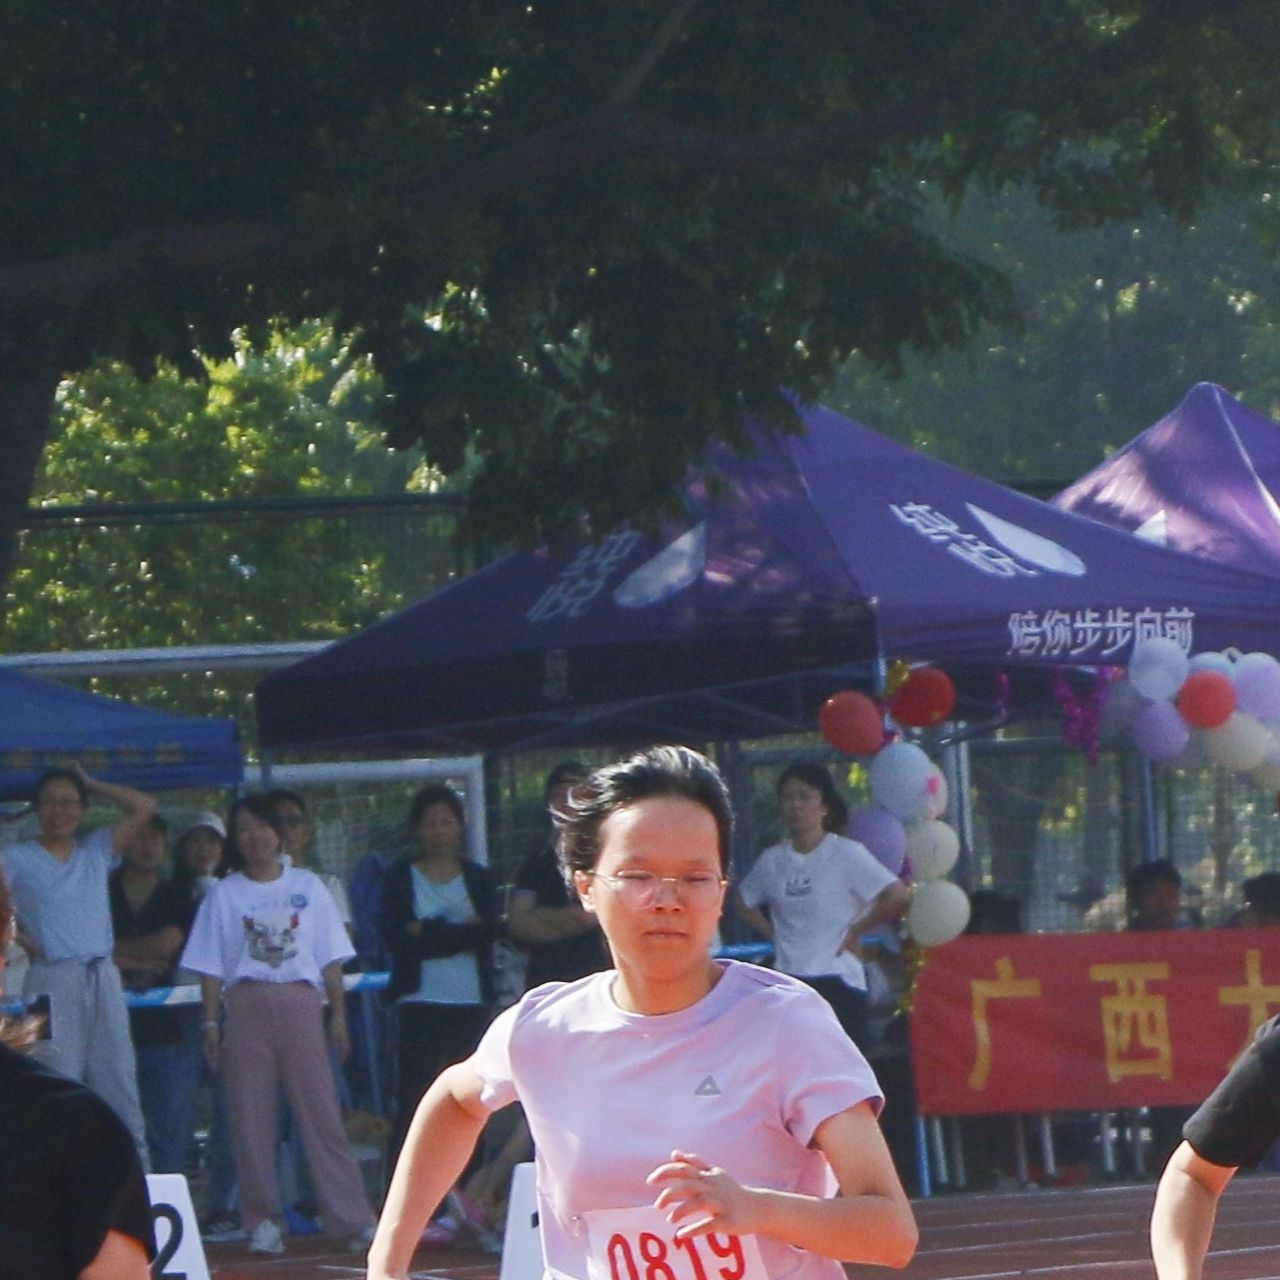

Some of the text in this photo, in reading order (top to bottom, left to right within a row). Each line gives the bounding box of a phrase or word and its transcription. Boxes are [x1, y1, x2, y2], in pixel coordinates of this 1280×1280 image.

[1006, 606, 1196, 656] 陪你步步向前
